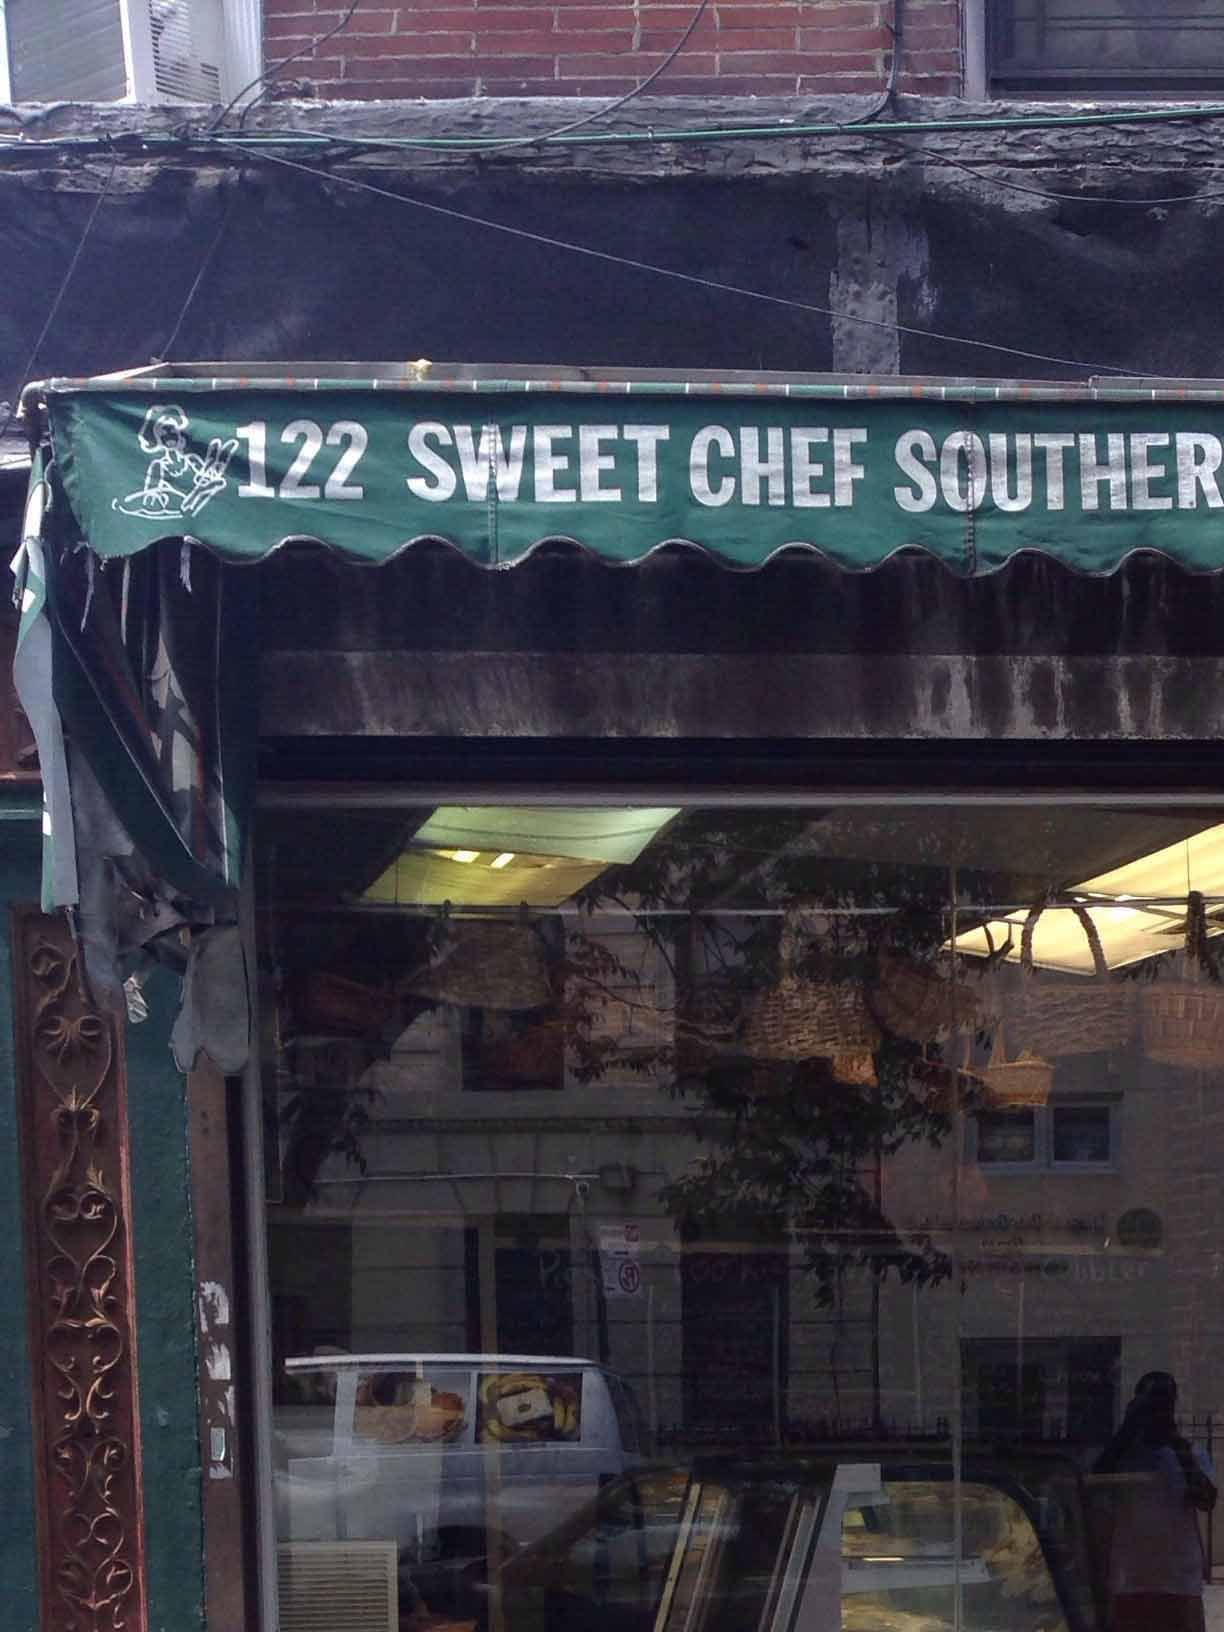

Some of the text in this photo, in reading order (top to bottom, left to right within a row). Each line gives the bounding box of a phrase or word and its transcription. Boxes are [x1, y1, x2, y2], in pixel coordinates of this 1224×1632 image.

[237, 420, 369, 499] 122
[406, 422, 670, 503] SWEET
[690, 426, 867, 507] CHEF
